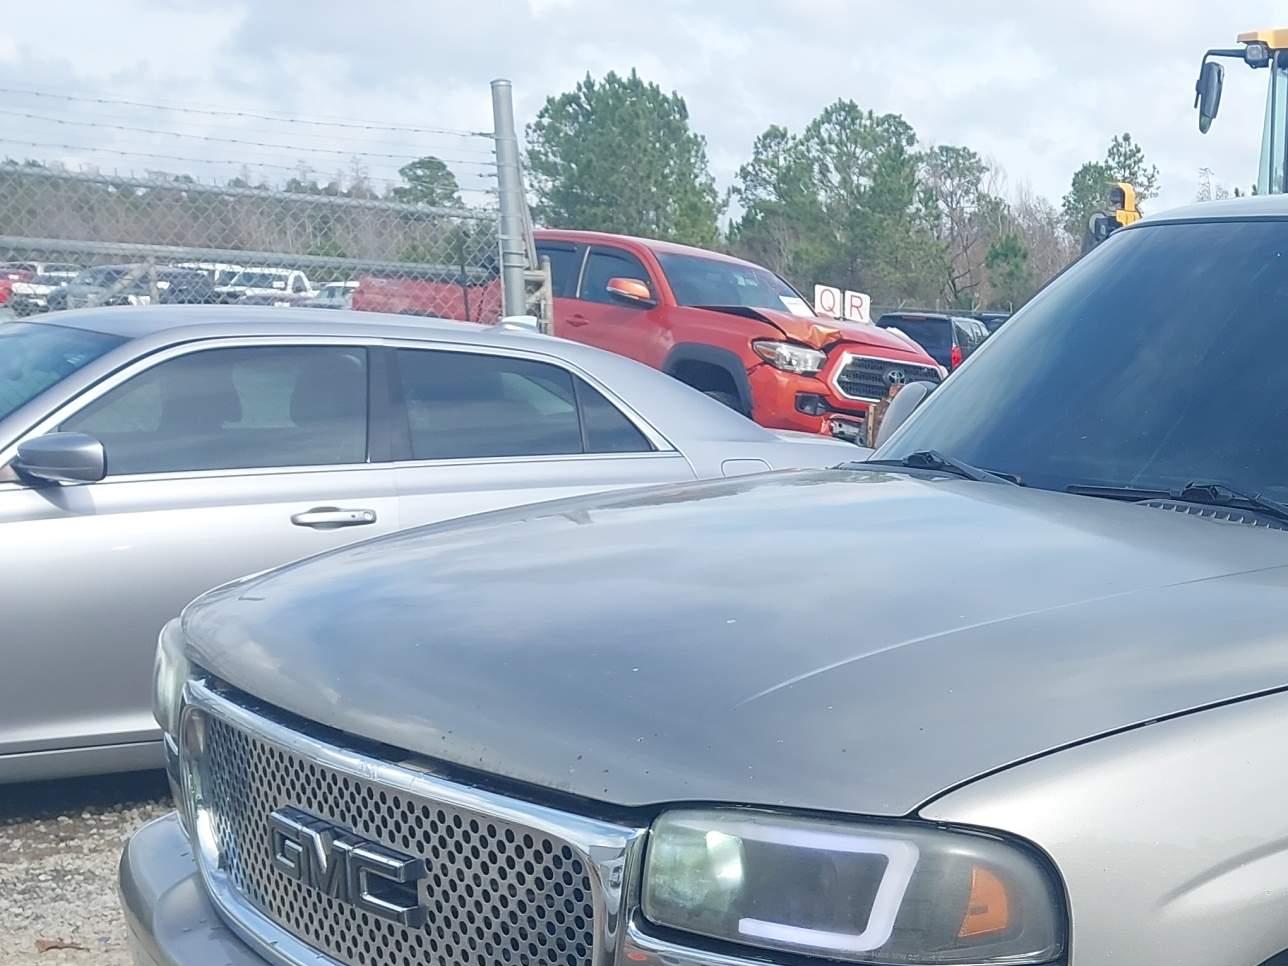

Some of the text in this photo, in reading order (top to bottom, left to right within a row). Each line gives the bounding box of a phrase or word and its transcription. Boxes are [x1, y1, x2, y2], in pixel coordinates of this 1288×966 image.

[820, 288, 864, 321] Q R
[269, 805, 428, 930] GMC
